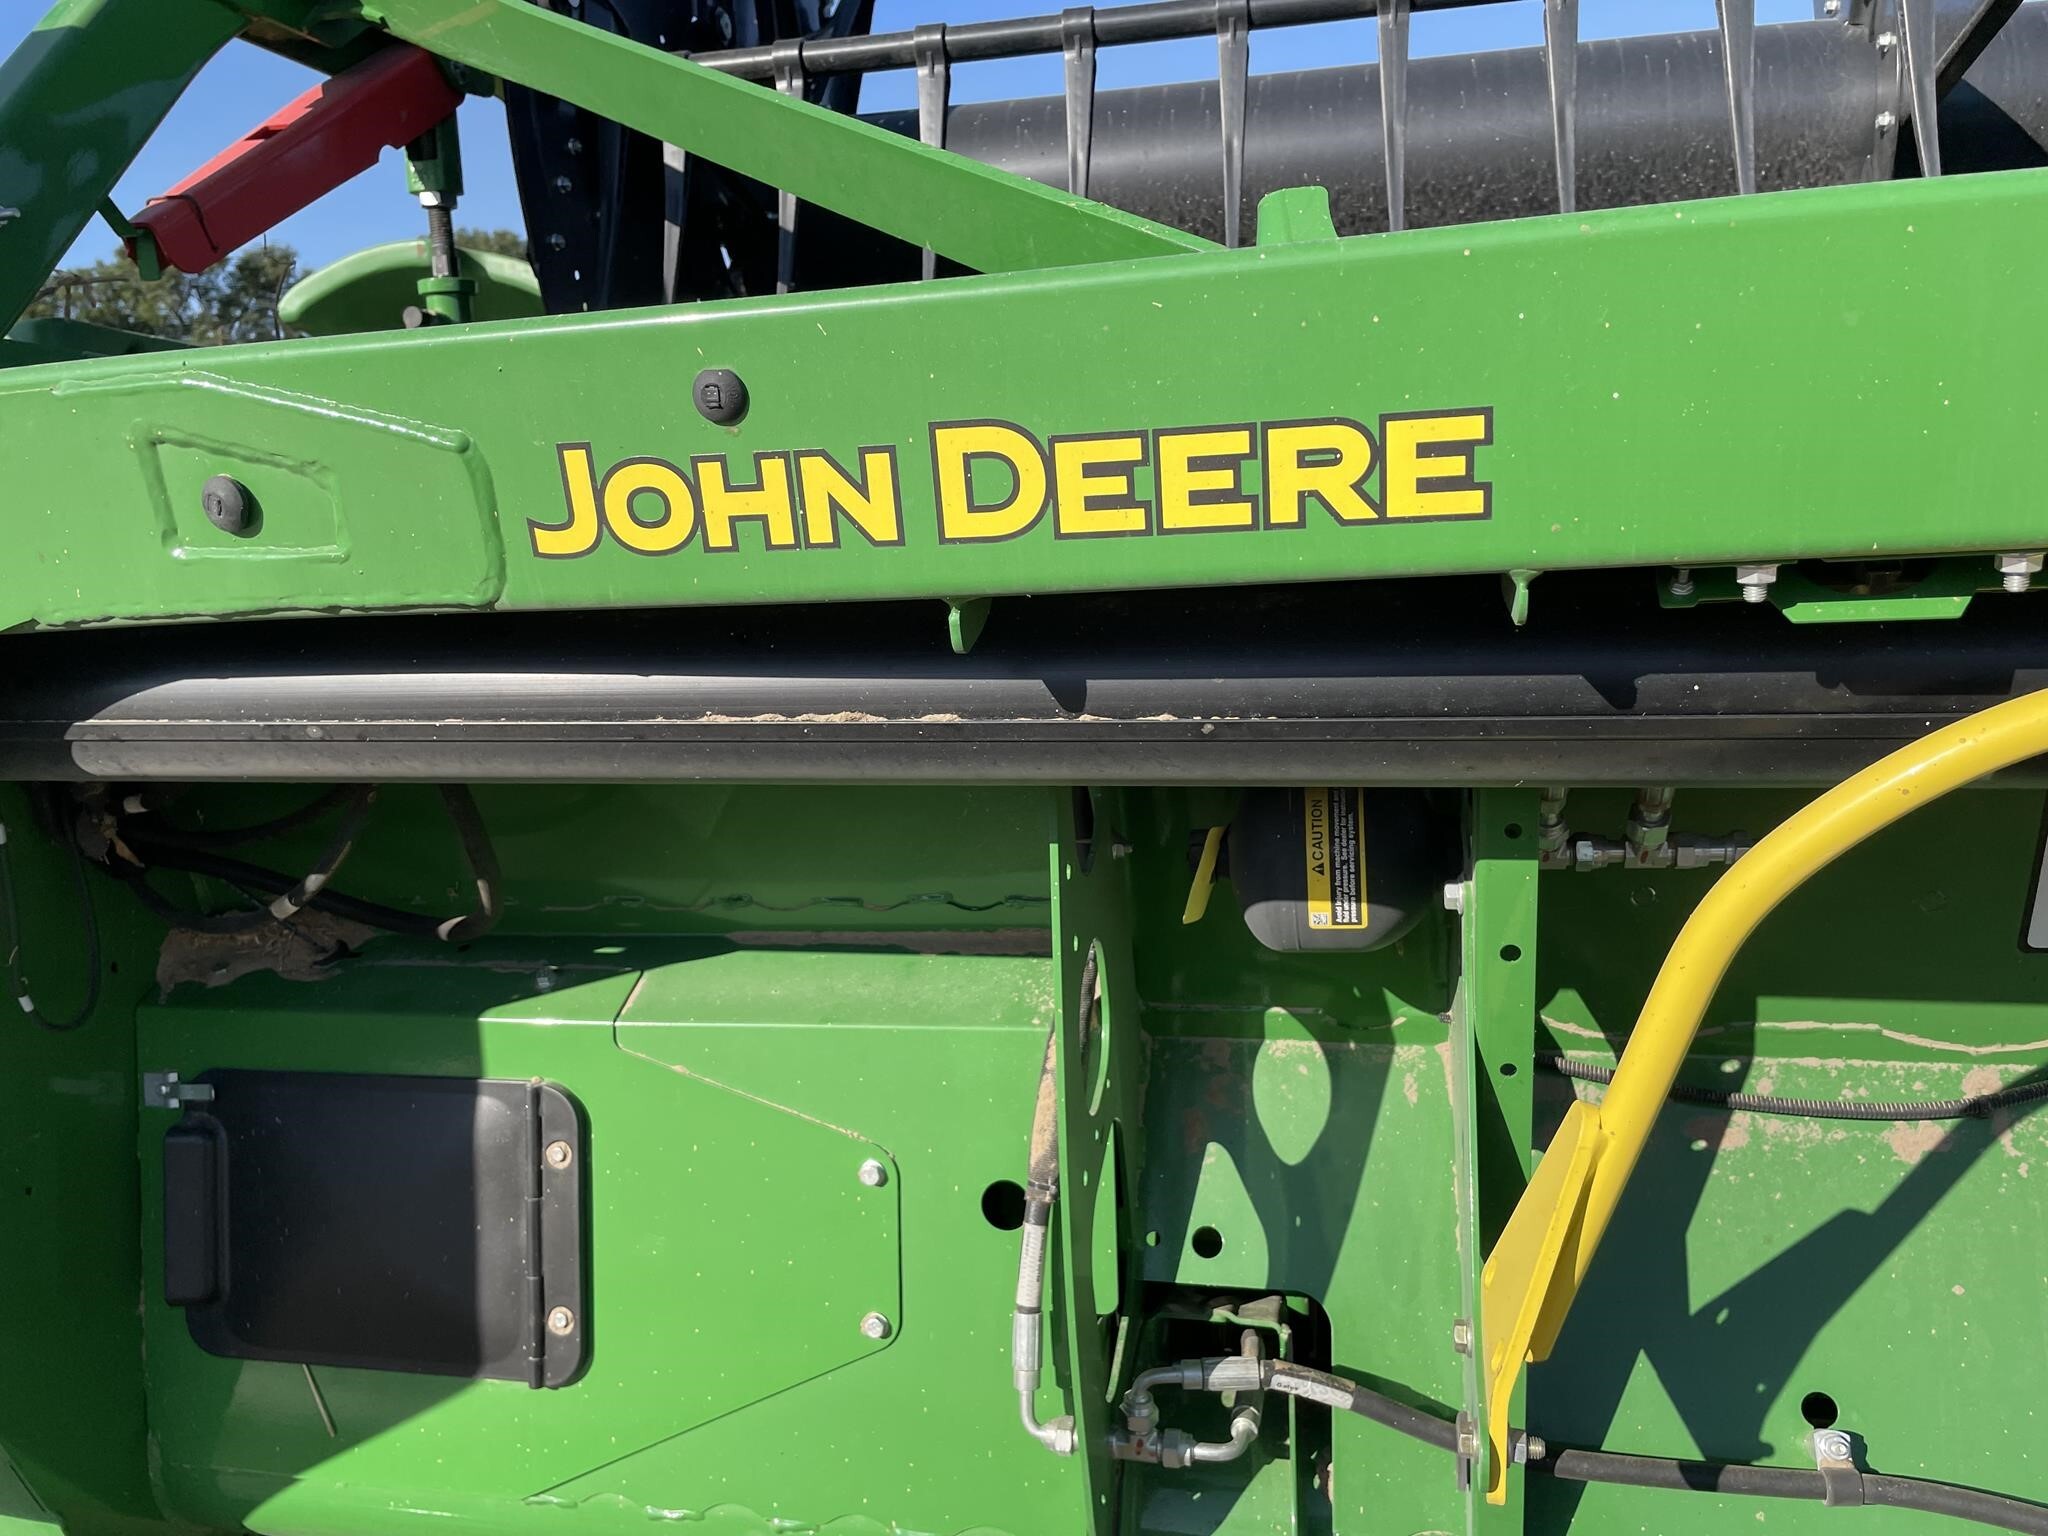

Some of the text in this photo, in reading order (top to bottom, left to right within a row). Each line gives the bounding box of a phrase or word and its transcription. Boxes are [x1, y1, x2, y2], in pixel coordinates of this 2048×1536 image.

[527, 406, 1494, 558] JOHN DEERE
[1311, 800, 1324, 860] CAUTION
[1348, 812, 1356, 838] system.
[1349, 839, 1357, 872] servicing
[1342, 863, 1350, 893] pressure.
